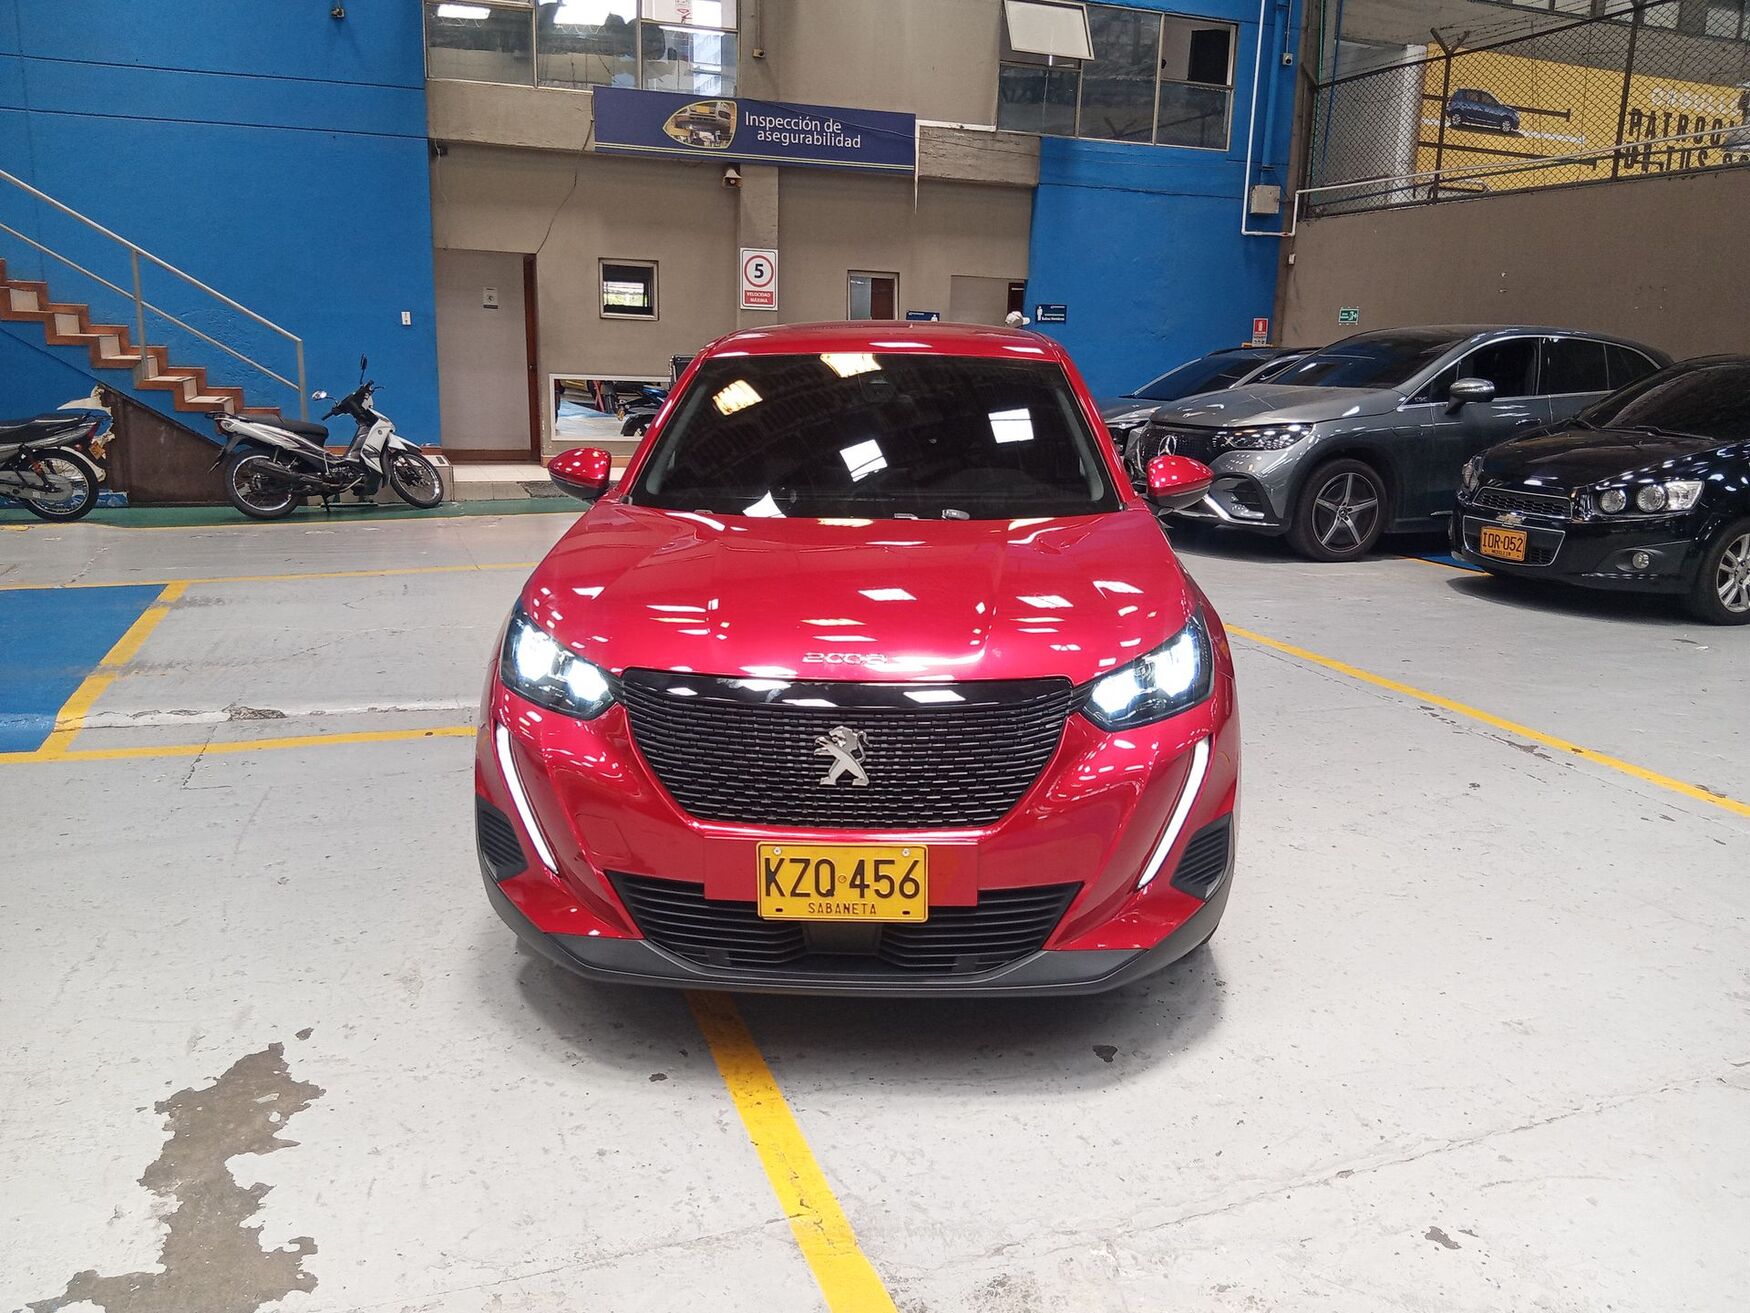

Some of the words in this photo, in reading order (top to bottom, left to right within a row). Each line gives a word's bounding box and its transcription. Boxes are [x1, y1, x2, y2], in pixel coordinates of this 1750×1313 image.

[745, 111, 820, 132] Inspección
[824, 119, 842, 133] de
[757, 130, 861, 149] asegurabilidad
[754, 263, 764, 279] 5
[808, 902, 877, 915] SABANETA
